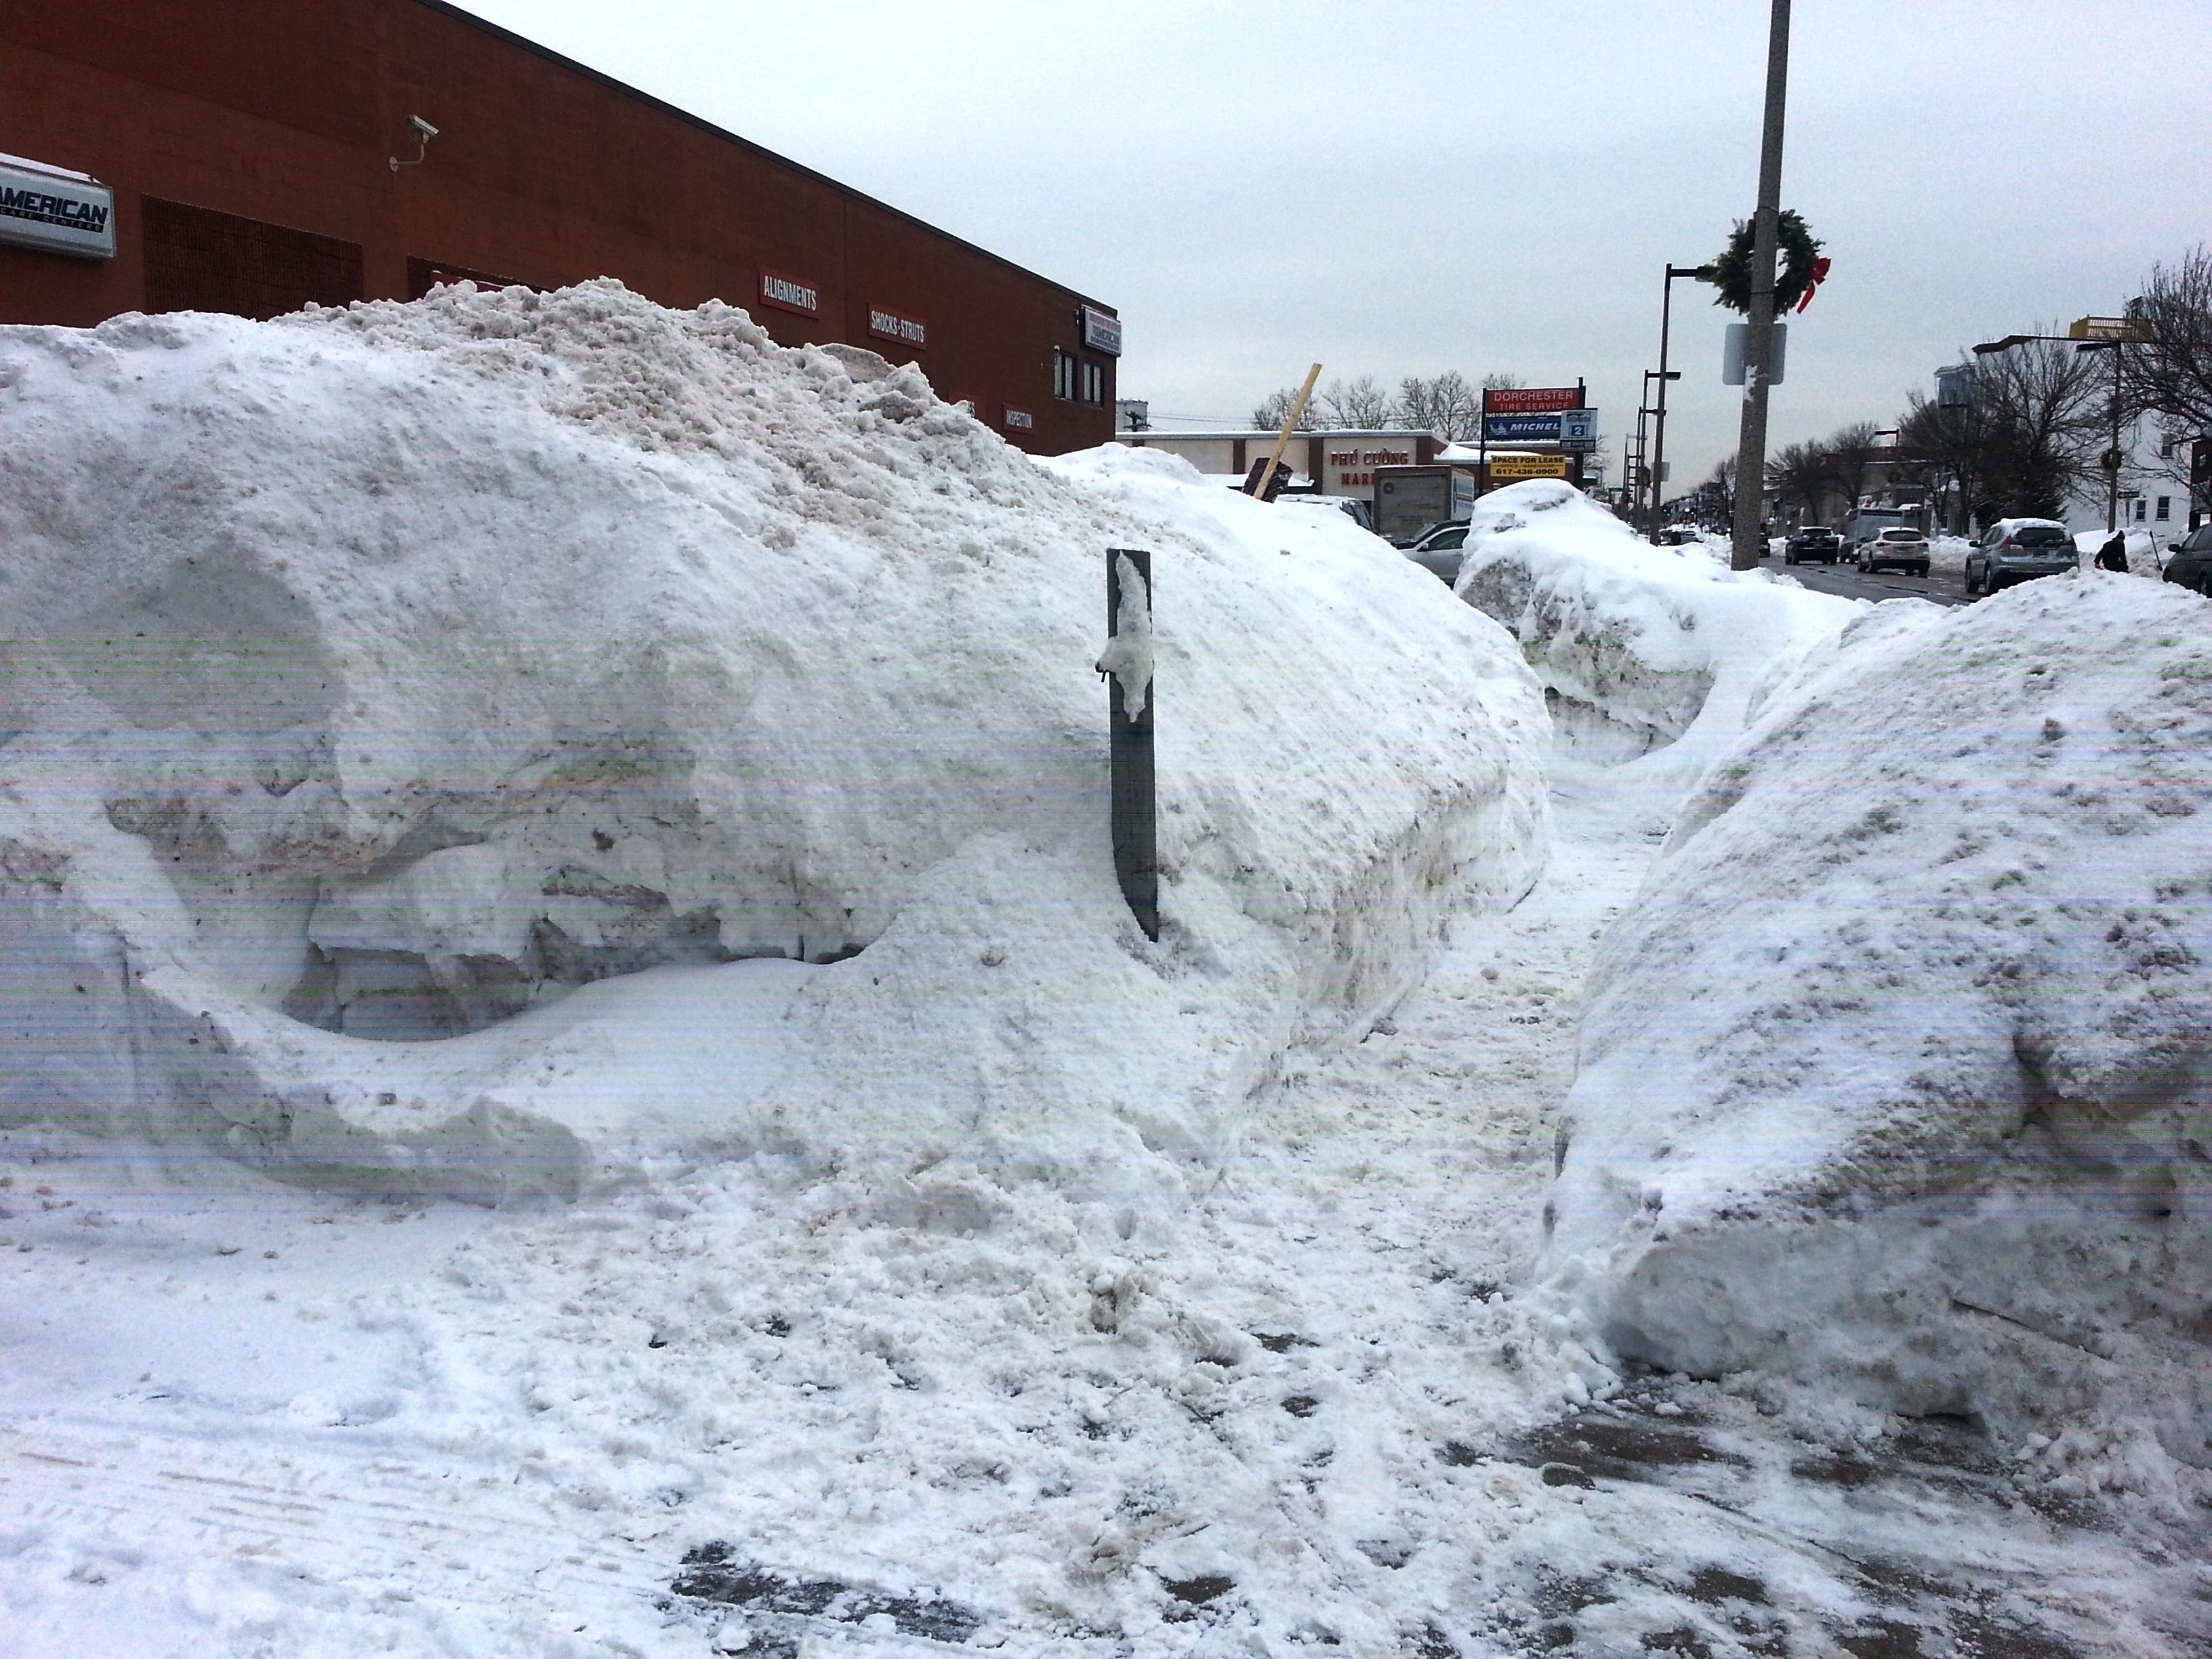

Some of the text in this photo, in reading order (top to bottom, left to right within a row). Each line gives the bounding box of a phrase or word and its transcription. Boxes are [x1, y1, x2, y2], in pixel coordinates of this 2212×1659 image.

[764, 275, 817, 311] ALIGNMENTS
[1494, 391, 1573, 402] DORCHESTER
[1525, 401, 1569, 410] SERVICE
[1574, 426, 1582, 435] 2
